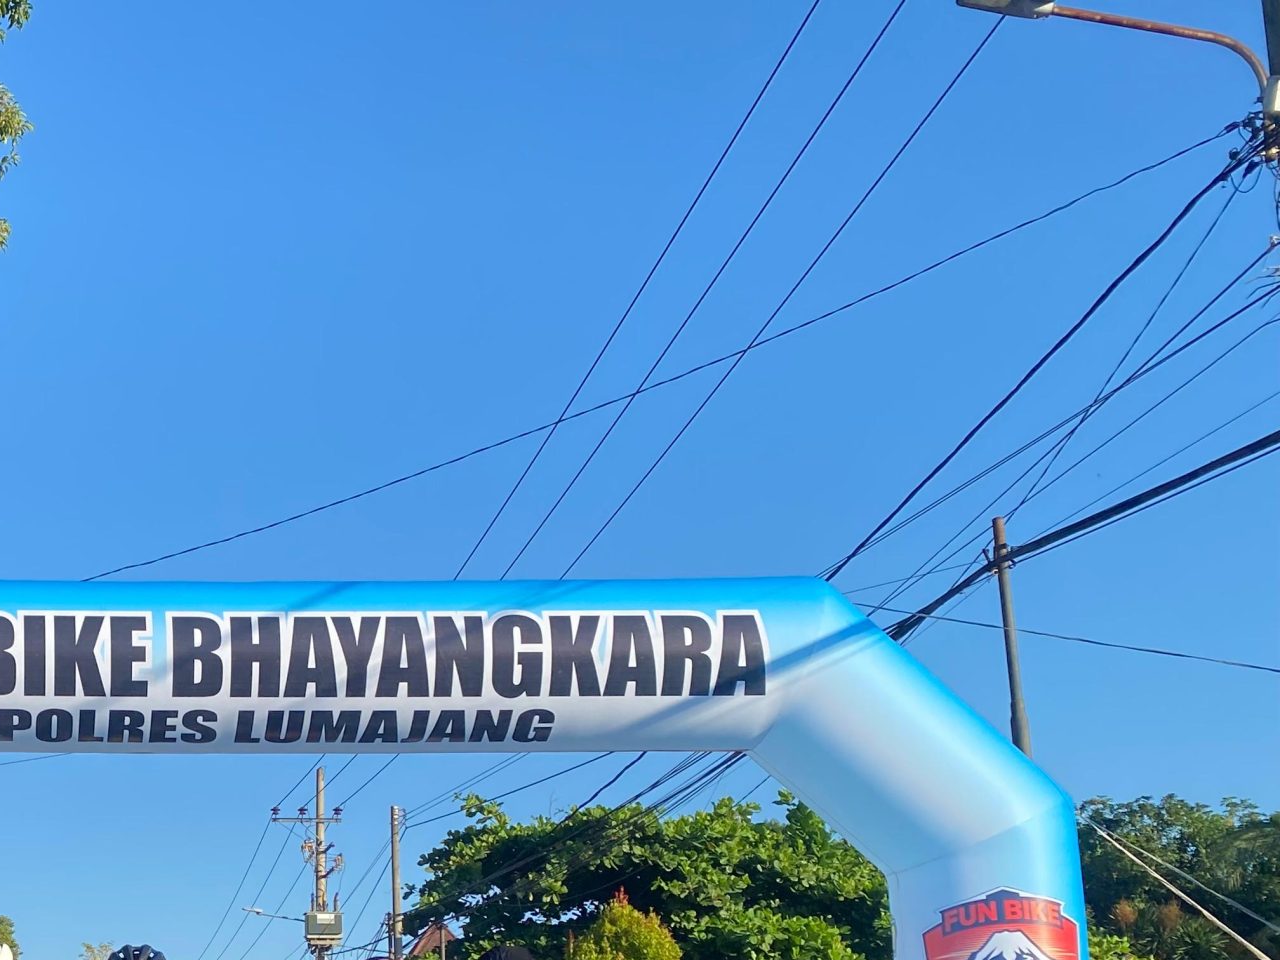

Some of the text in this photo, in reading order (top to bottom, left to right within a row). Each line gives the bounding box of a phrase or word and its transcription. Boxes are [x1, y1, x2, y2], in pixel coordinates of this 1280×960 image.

[170, 613, 768, 700] BHAYANGKARA
[233, 708, 556, 744] LUMAJANG
[943, 899, 1062, 933] FUN BIKE
